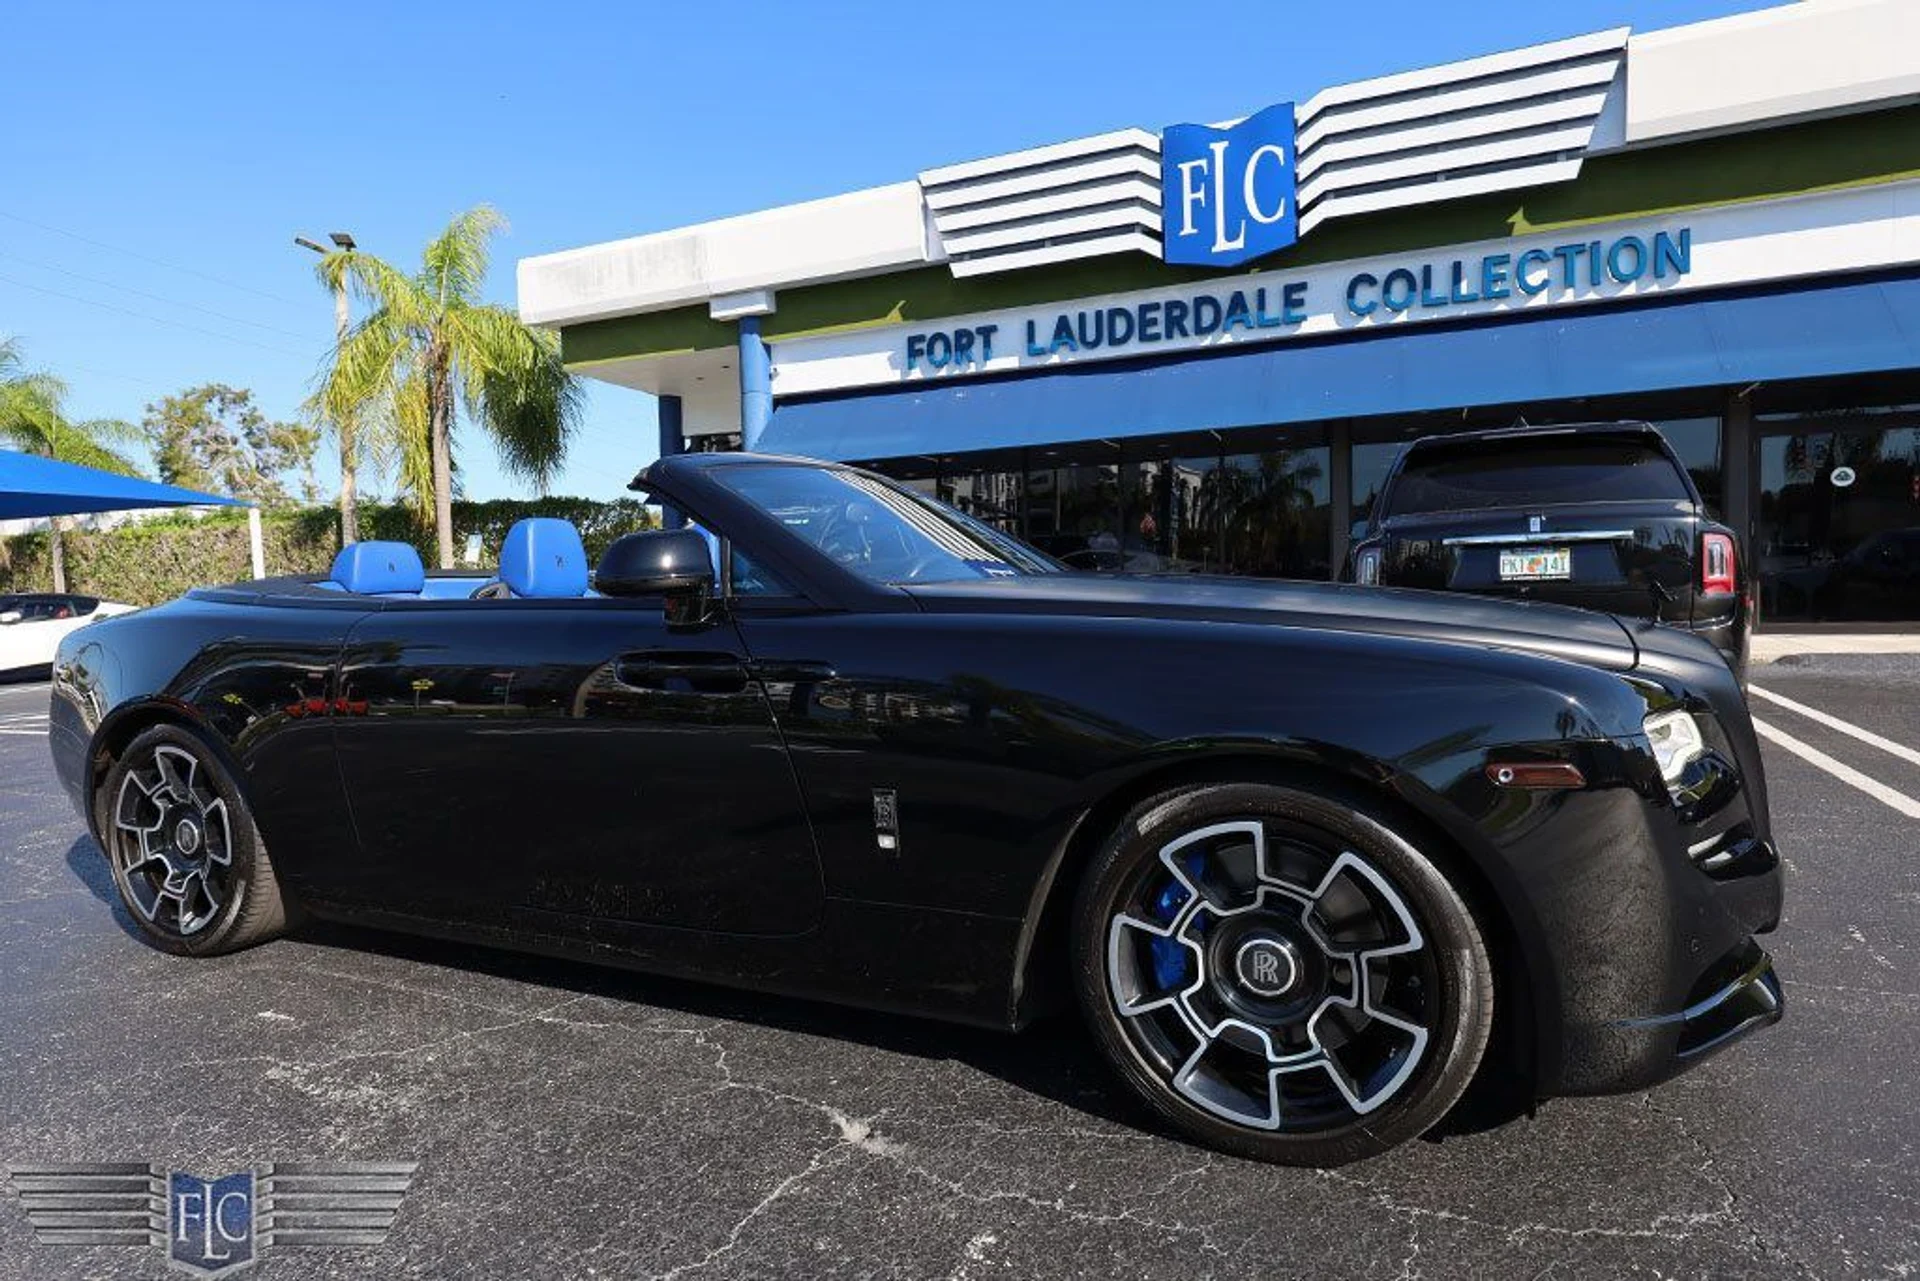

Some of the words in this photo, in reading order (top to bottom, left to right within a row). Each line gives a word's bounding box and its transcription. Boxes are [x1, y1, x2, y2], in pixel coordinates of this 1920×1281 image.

[1177, 140, 1285, 254] FLC
[906, 324, 998, 370] FORT
[1026, 281, 1309, 357] LAUDERDALE
[1346, 228, 1691, 316] COLLECTION
